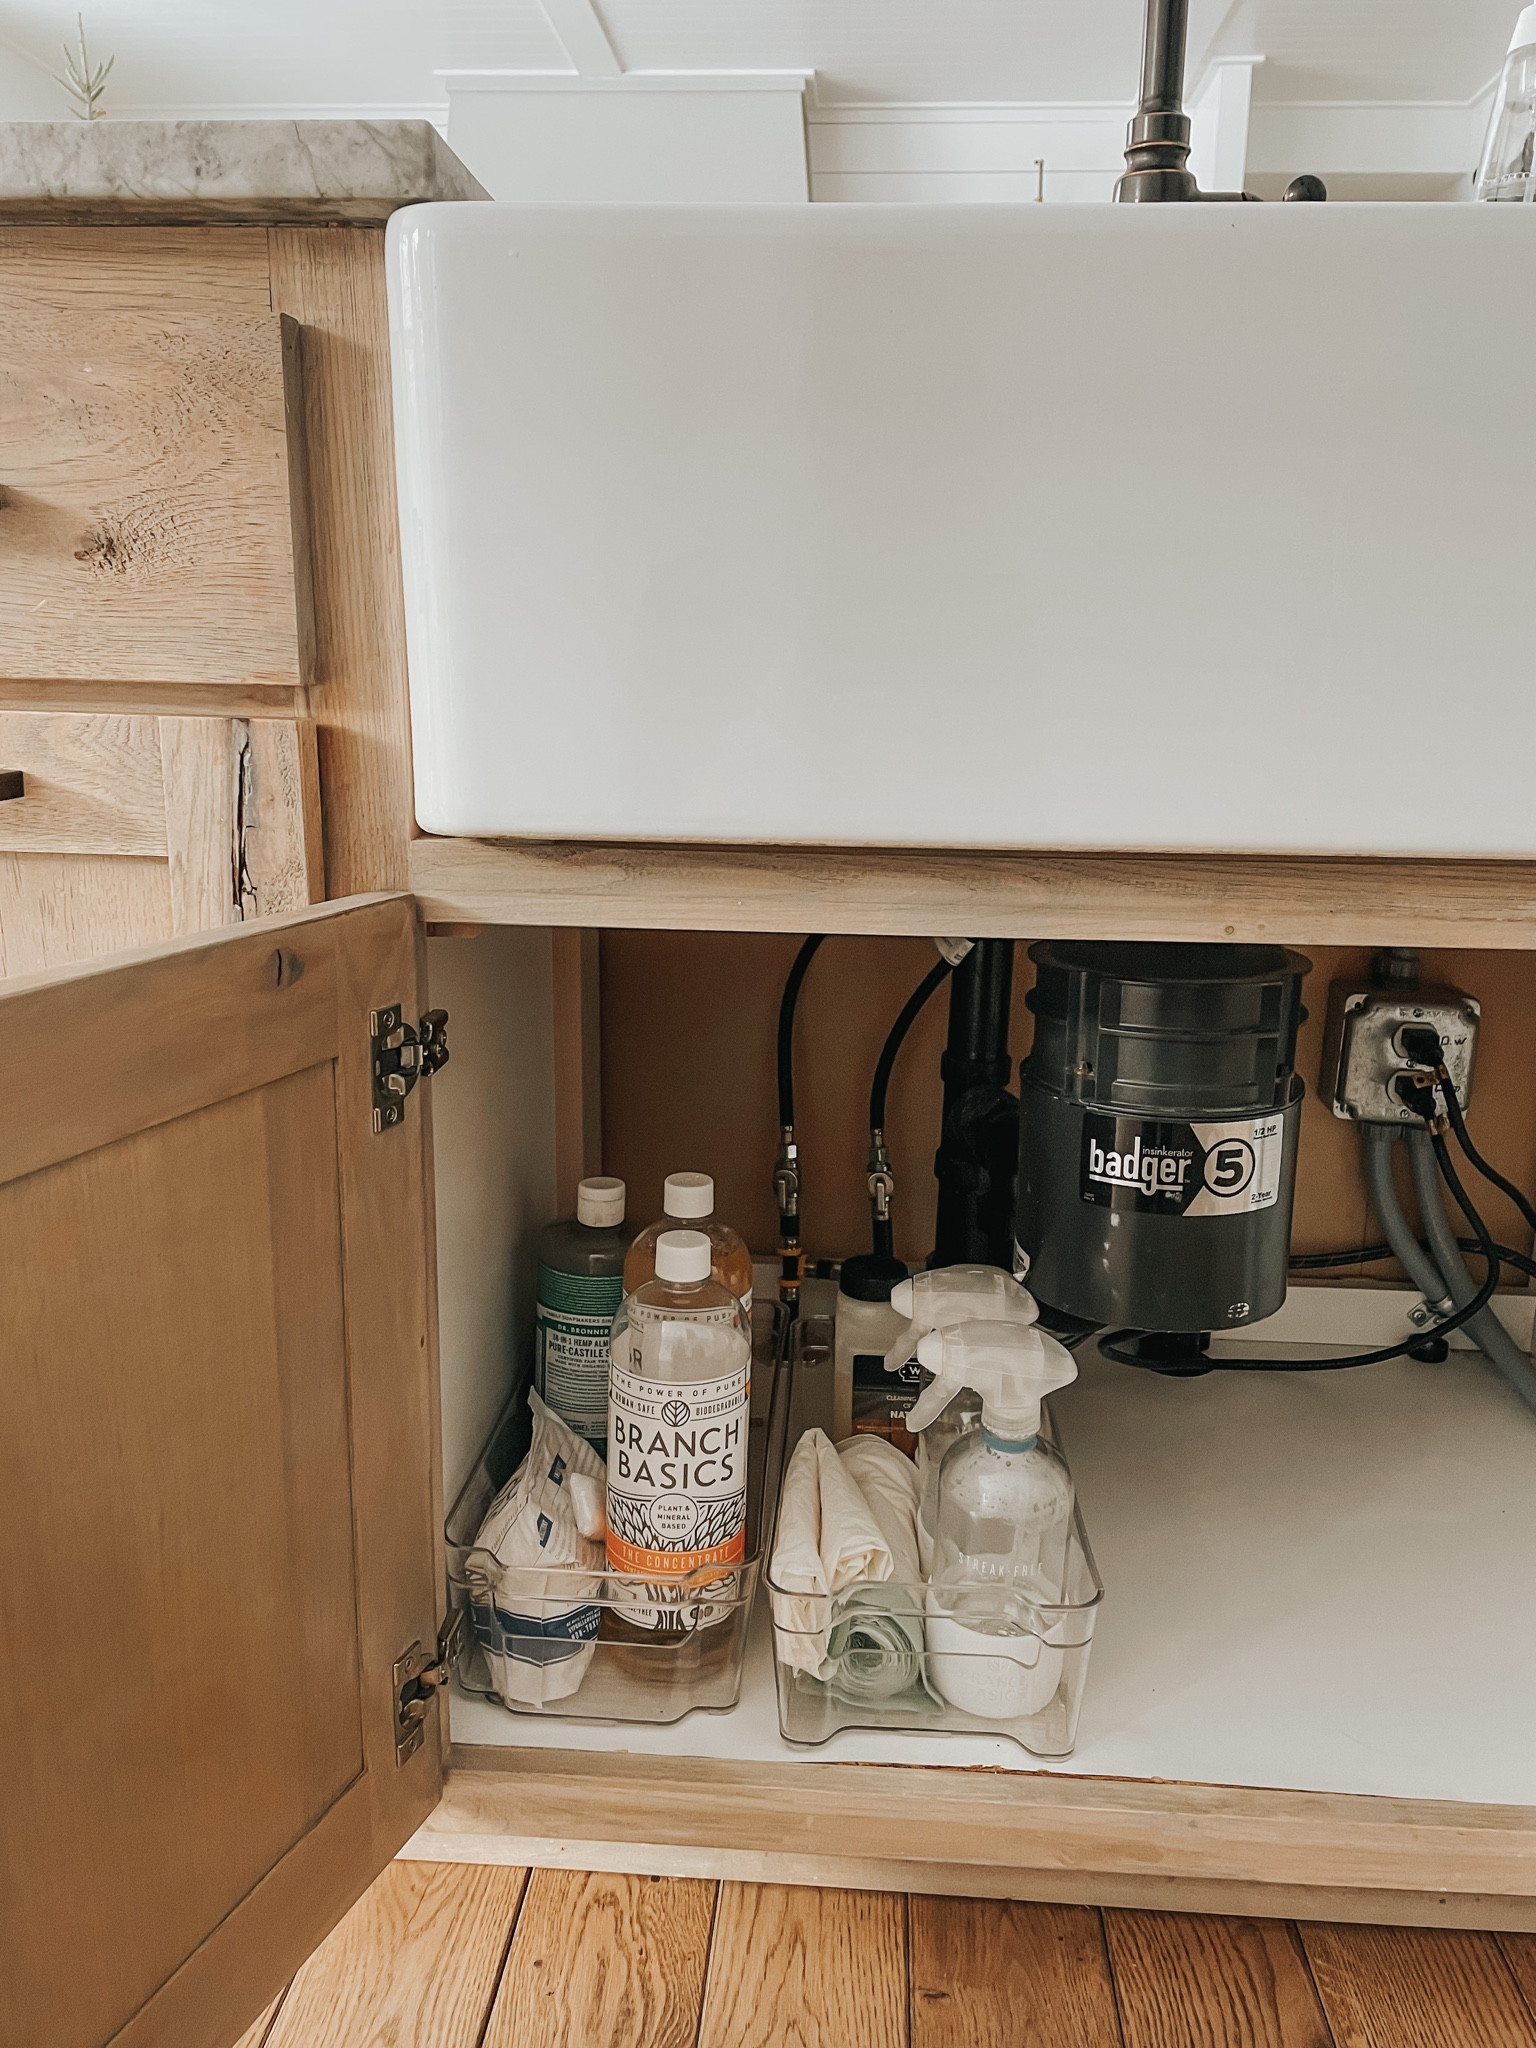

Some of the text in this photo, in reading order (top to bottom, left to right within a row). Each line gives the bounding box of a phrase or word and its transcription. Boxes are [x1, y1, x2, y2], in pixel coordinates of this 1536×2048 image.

[1267, 1125, 1277, 1133] HP
[1142, 1145, 1194, 1157] insinkerator
[1089, 1136, 1192, 1196] badger
[1213, 1149, 1244, 1188] 5
[1252, 1191, 1272, 1200] 2-Year
[557, 1323, 609, 1336] DR. BRONNER
[548, 1340, 604, 1358] PURE-CASTILE
[573, 1338, 593, 1348] HEMP
[594, 1339, 609, 1348] ALM
[616, 1374, 742, 1398] THE POWER OF PURE
[695, 1392, 743, 1416] BIODEGRADABLE
[886, 1394, 917, 1402] CLEANING
[615, 1415, 740, 1458] BRANCH
[618, 1449, 734, 1490] BASICS
[658, 1504, 690, 1512] PLANT &
[657, 1513, 691, 1521] MINERAL
[661, 1522, 687, 1530] BASED
[622, 1545, 730, 1569] THE CONCENTRATE
[570, 1617, 600, 1640] NON-TOXI
